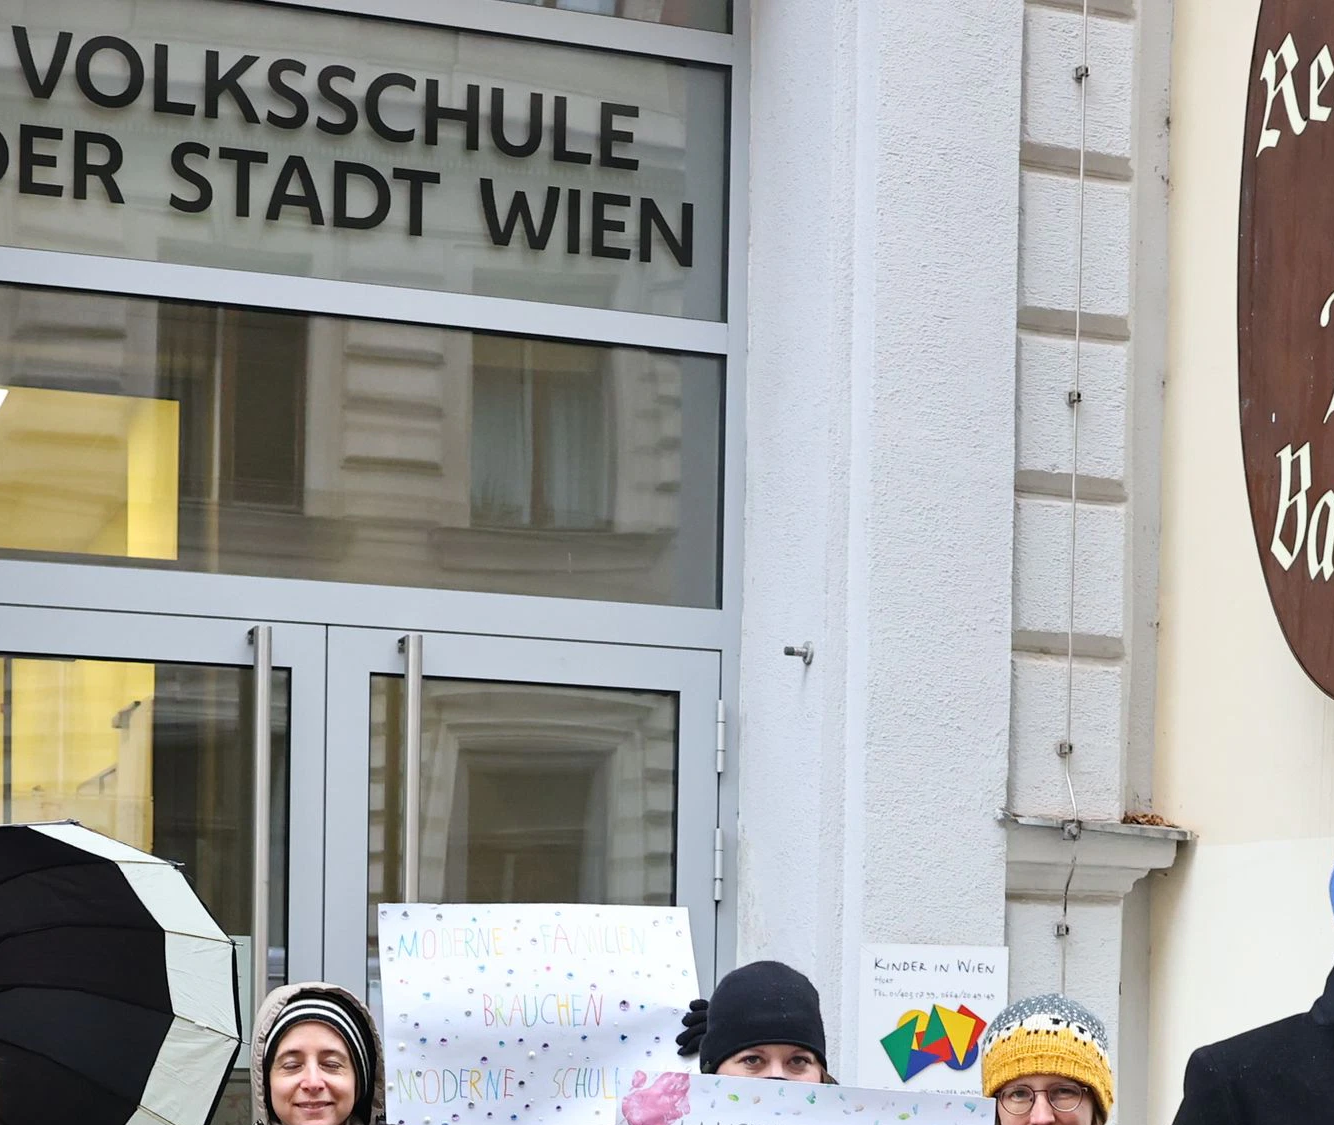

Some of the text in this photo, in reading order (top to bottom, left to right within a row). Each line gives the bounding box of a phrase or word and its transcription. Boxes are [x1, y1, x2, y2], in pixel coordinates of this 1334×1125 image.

[11, 26, 639, 171] VOLKSSCHULE
[169, 141, 440, 236] STADT
[480, 177, 694, 268] WIEN
[398, 924, 646, 959] MODERNE FAMILIEN
[873, 957, 928, 972] KINDER
[483, 993, 604, 1028] BRAUCHEN
[397, 1069, 515, 1104] MODERNE
